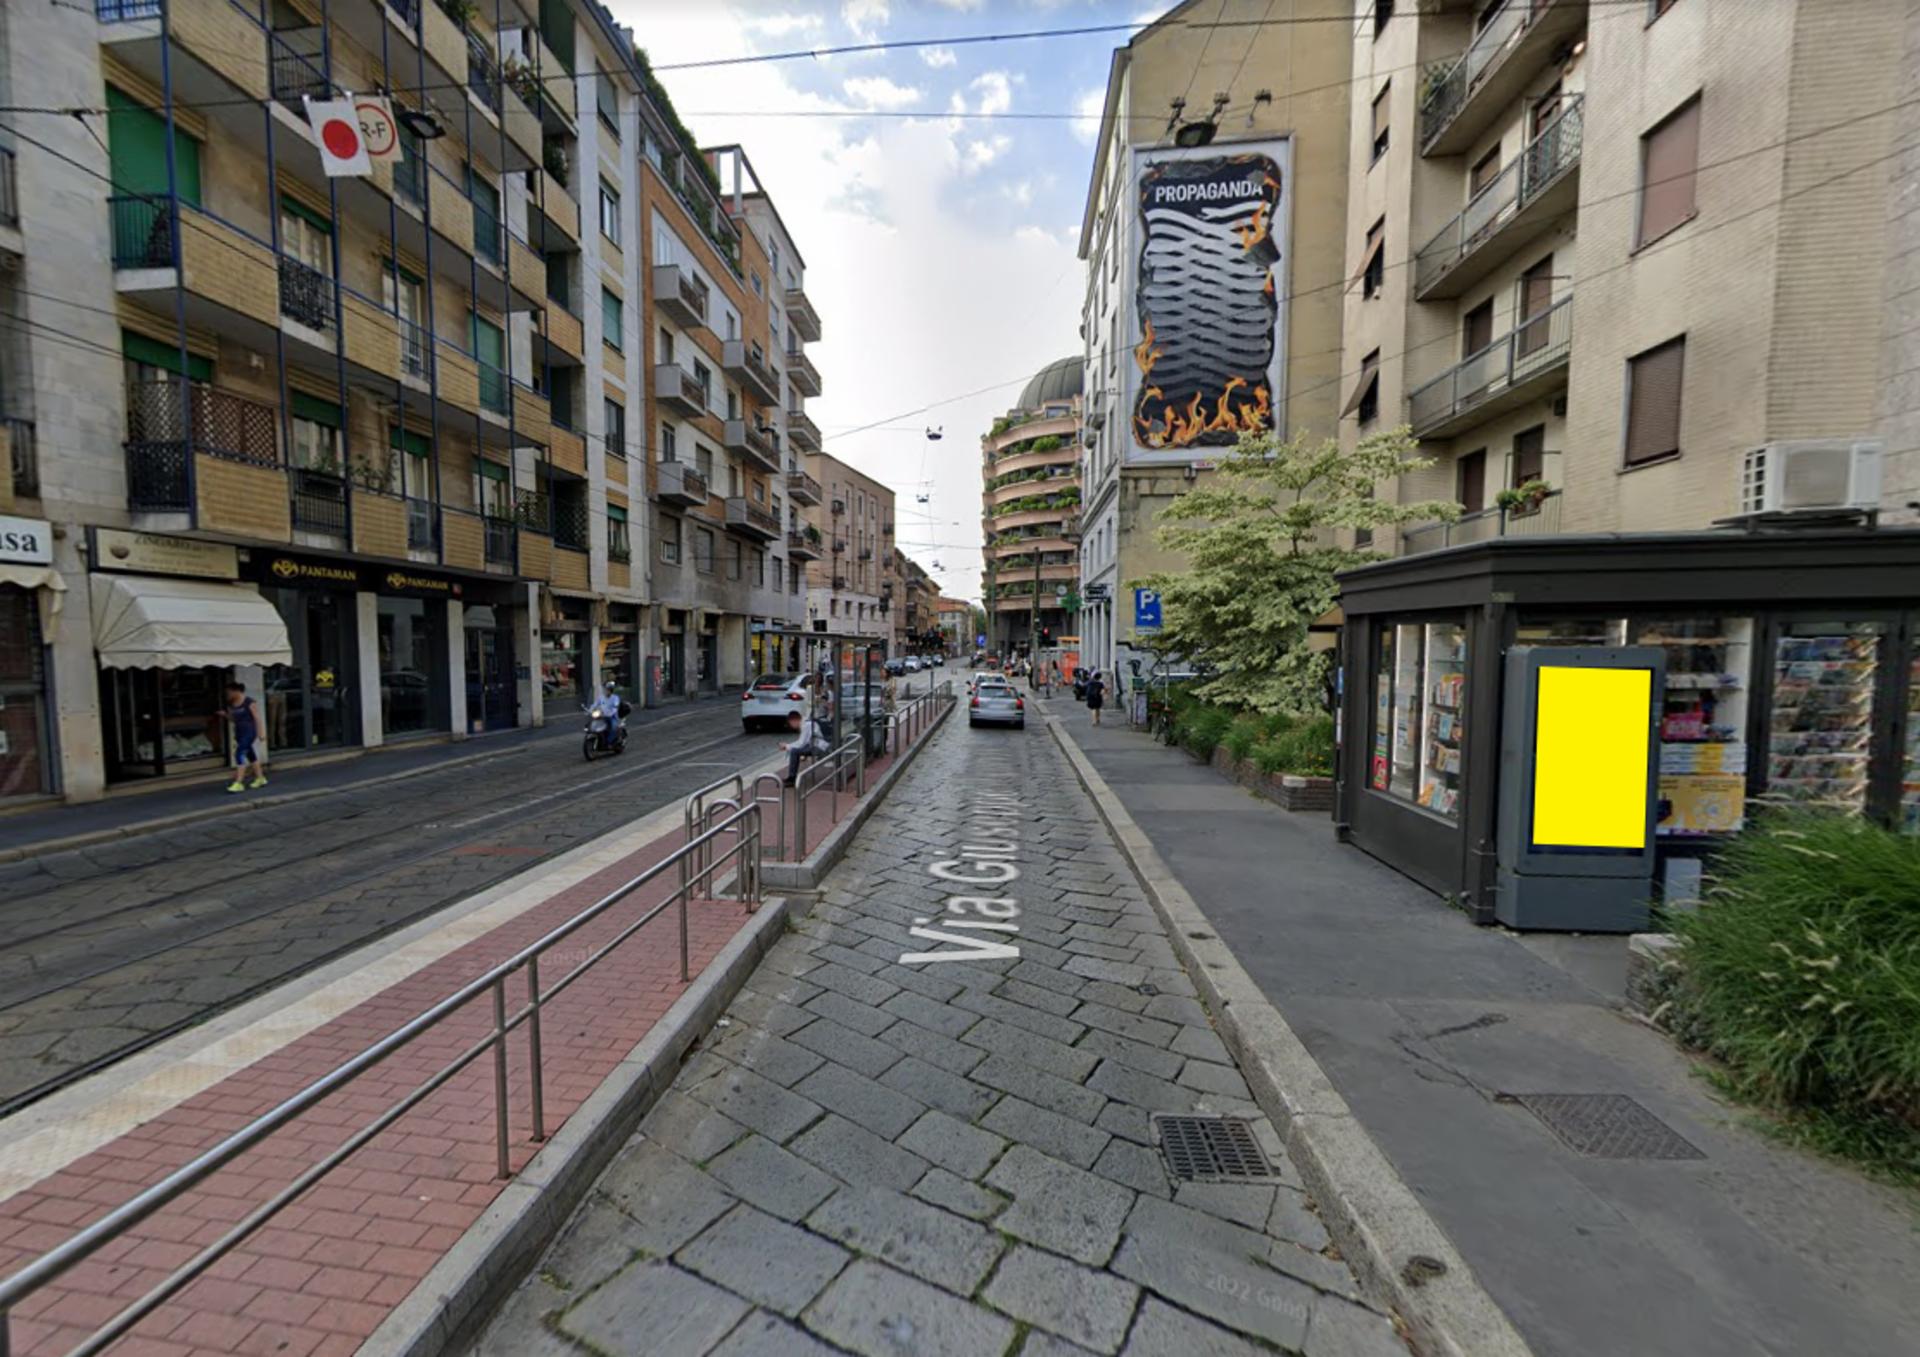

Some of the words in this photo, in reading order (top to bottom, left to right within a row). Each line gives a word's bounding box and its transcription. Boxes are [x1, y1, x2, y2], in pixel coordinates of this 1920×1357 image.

[1156, 181, 1263, 202] PROPAGANDA
[0, 532, 38, 553] sa
[300, 564, 357, 581] PANTAMAN
[407, 576, 449, 591] PANTAMAN
[1140, 590, 1155, 609] P
